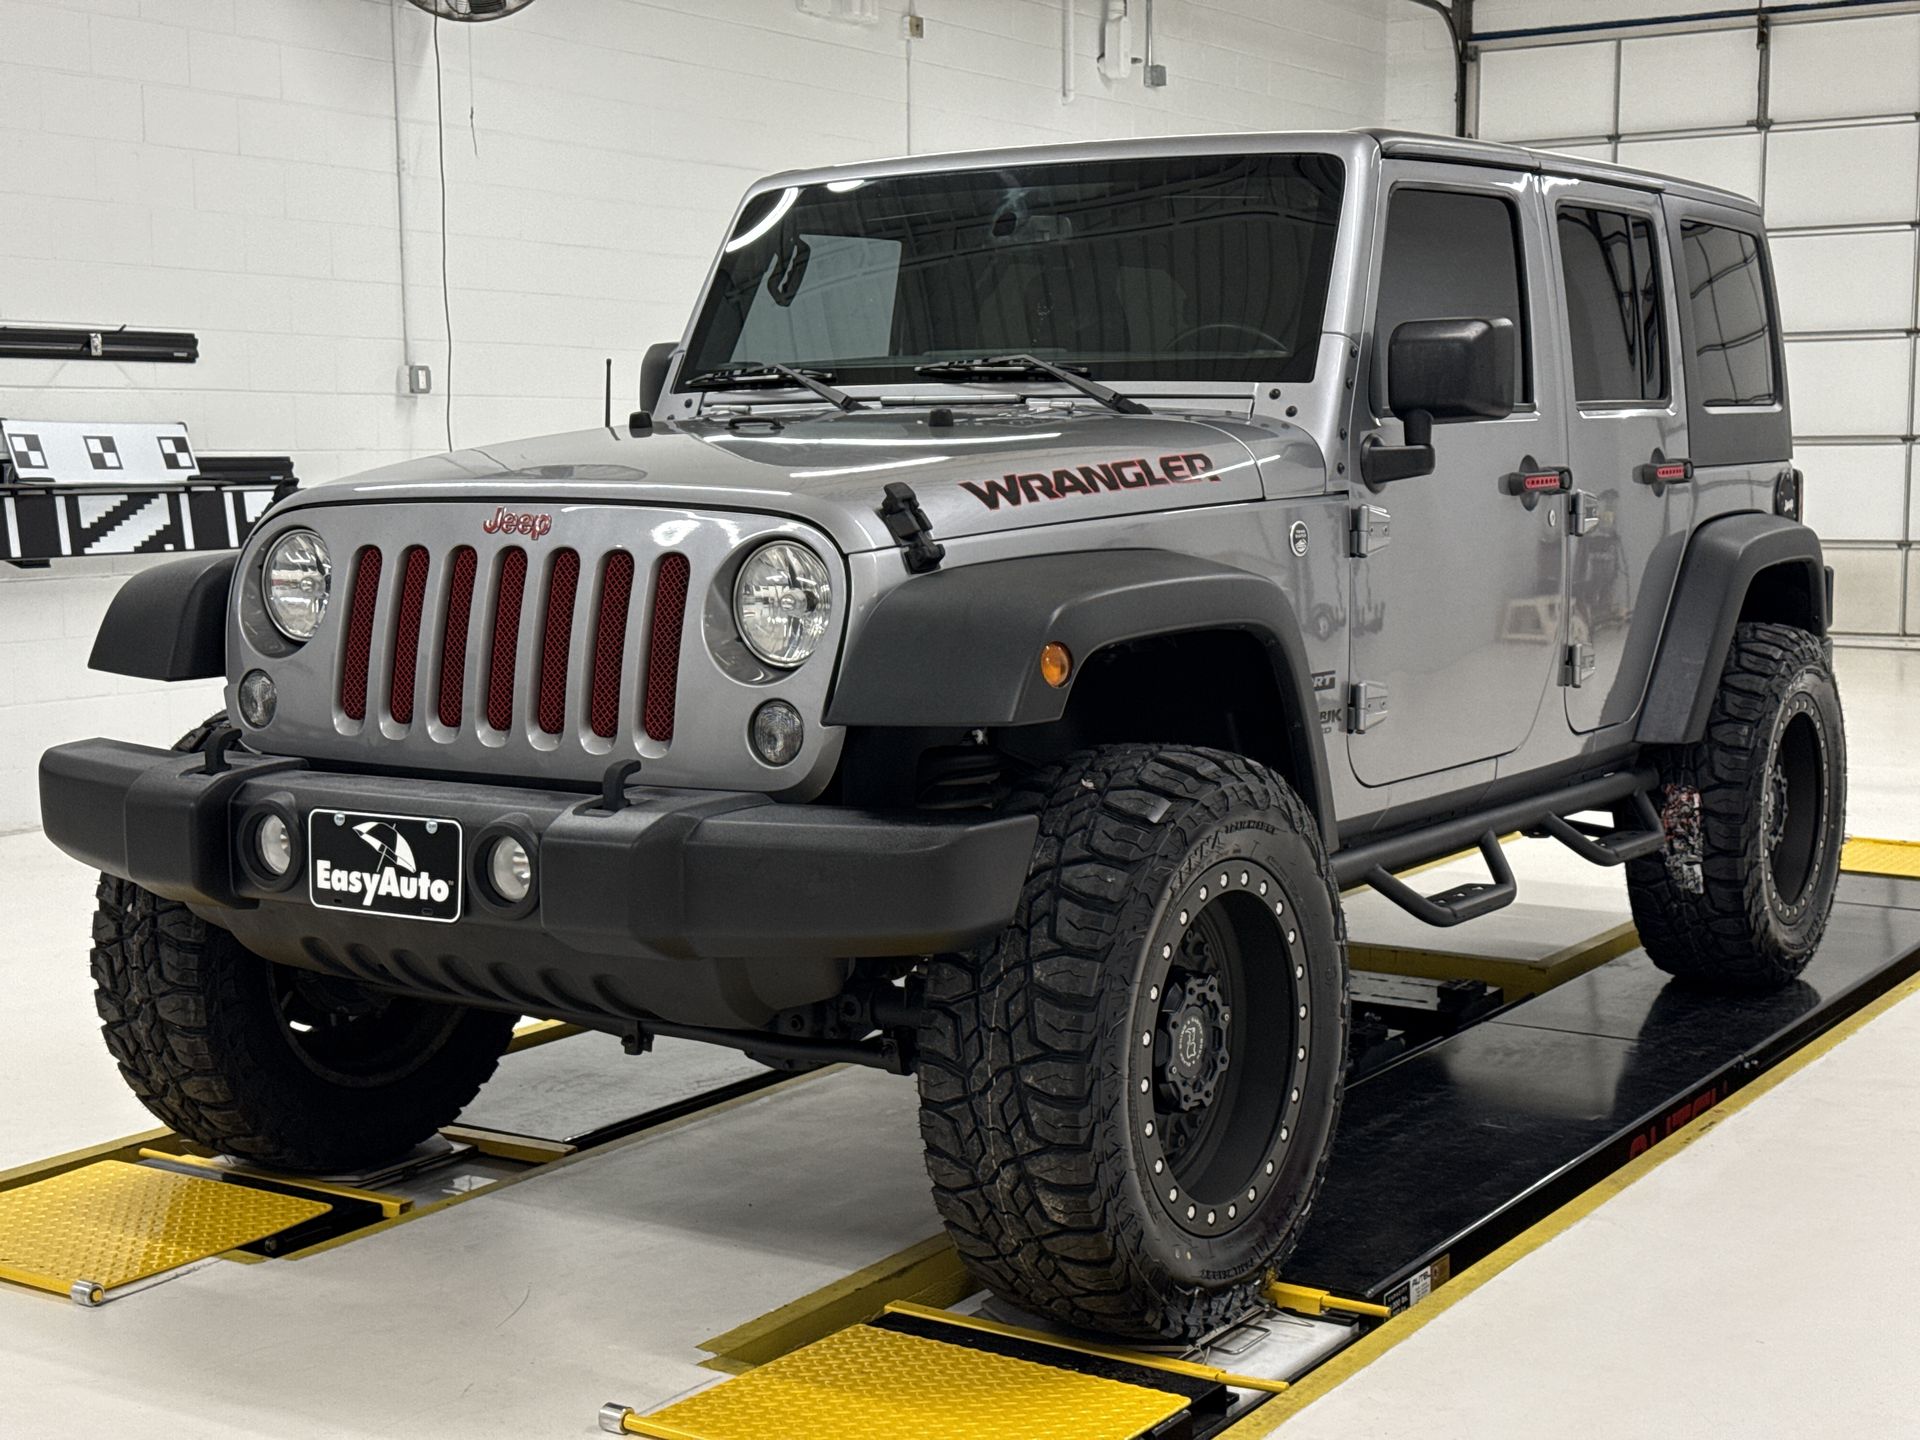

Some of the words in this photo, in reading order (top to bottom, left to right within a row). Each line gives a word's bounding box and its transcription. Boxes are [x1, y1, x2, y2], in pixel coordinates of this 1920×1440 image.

[958, 452, 1222, 511] WRANGLER
[483, 505, 552, 541] Jeep
[316, 859, 450, 907] EasyAuto
